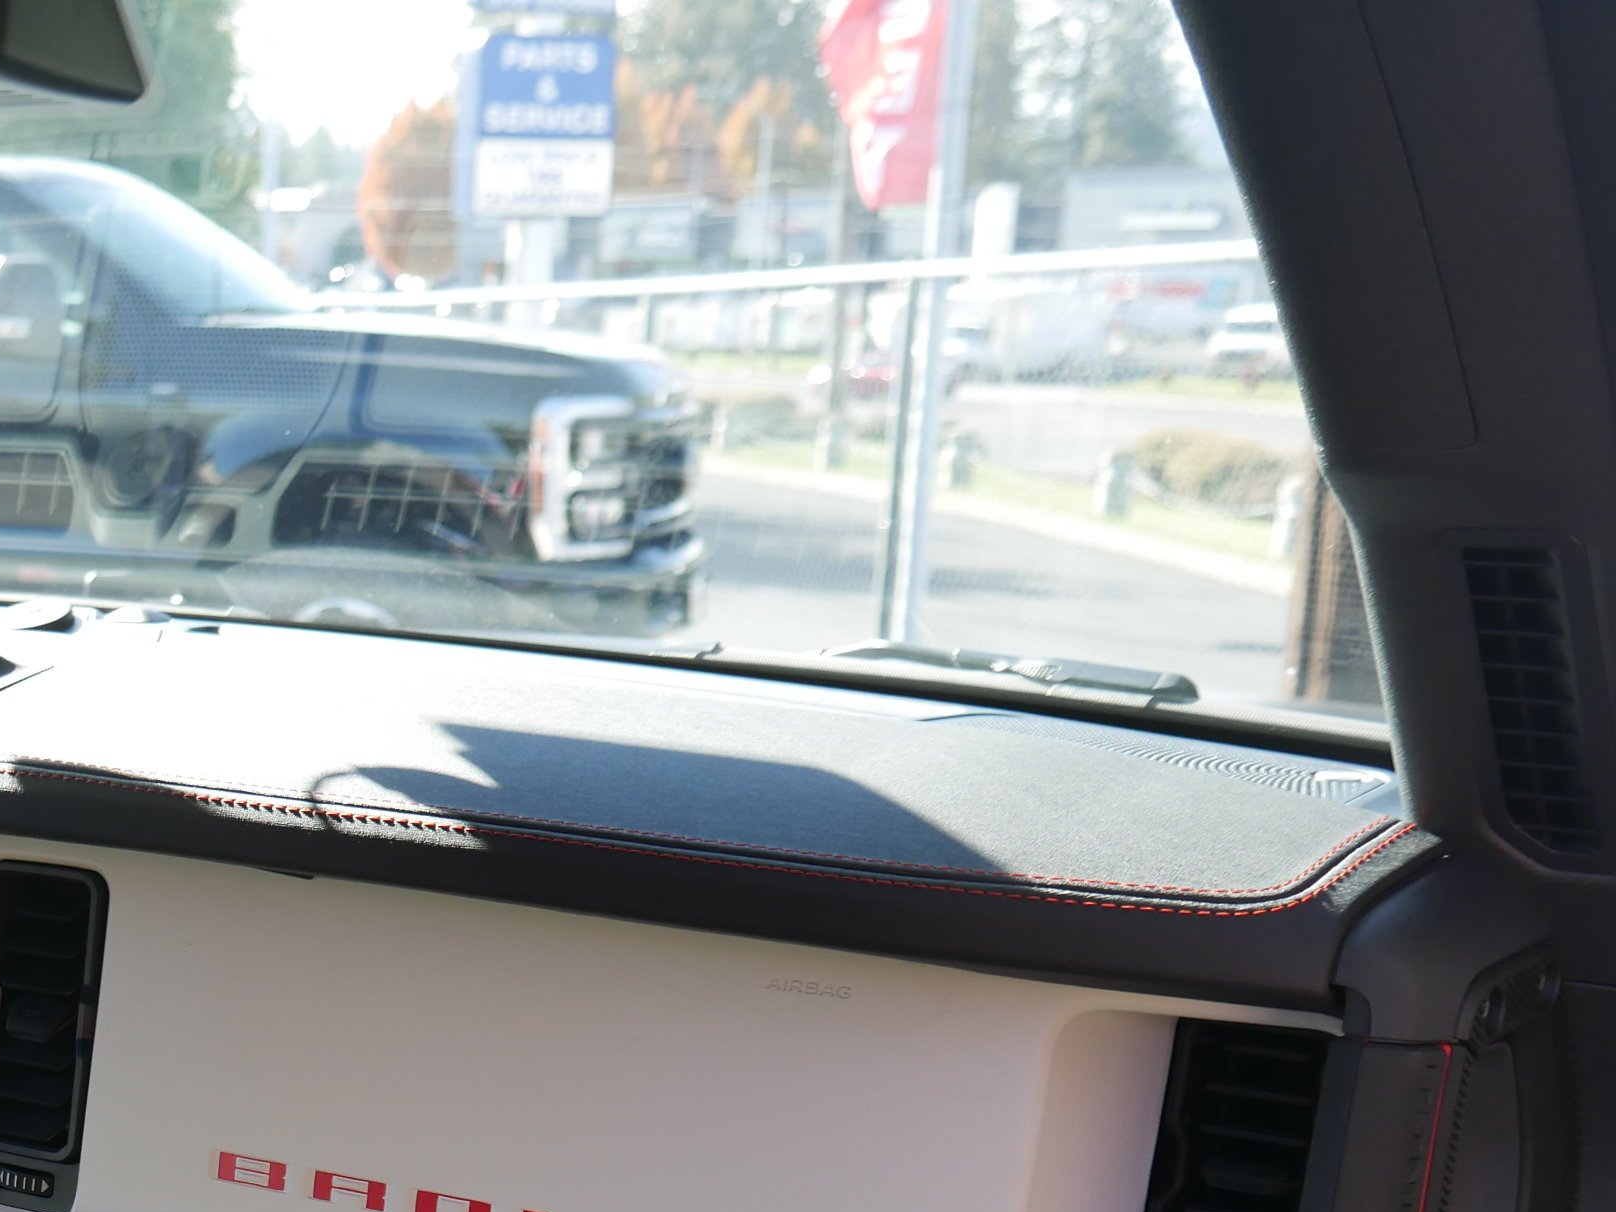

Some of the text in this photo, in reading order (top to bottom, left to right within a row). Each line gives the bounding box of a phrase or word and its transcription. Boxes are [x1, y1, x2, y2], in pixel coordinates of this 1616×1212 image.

[500, 39, 599, 74] PARTS
[483, 101, 613, 135] SERVICE
[765, 978, 852, 999] AIRBAG
